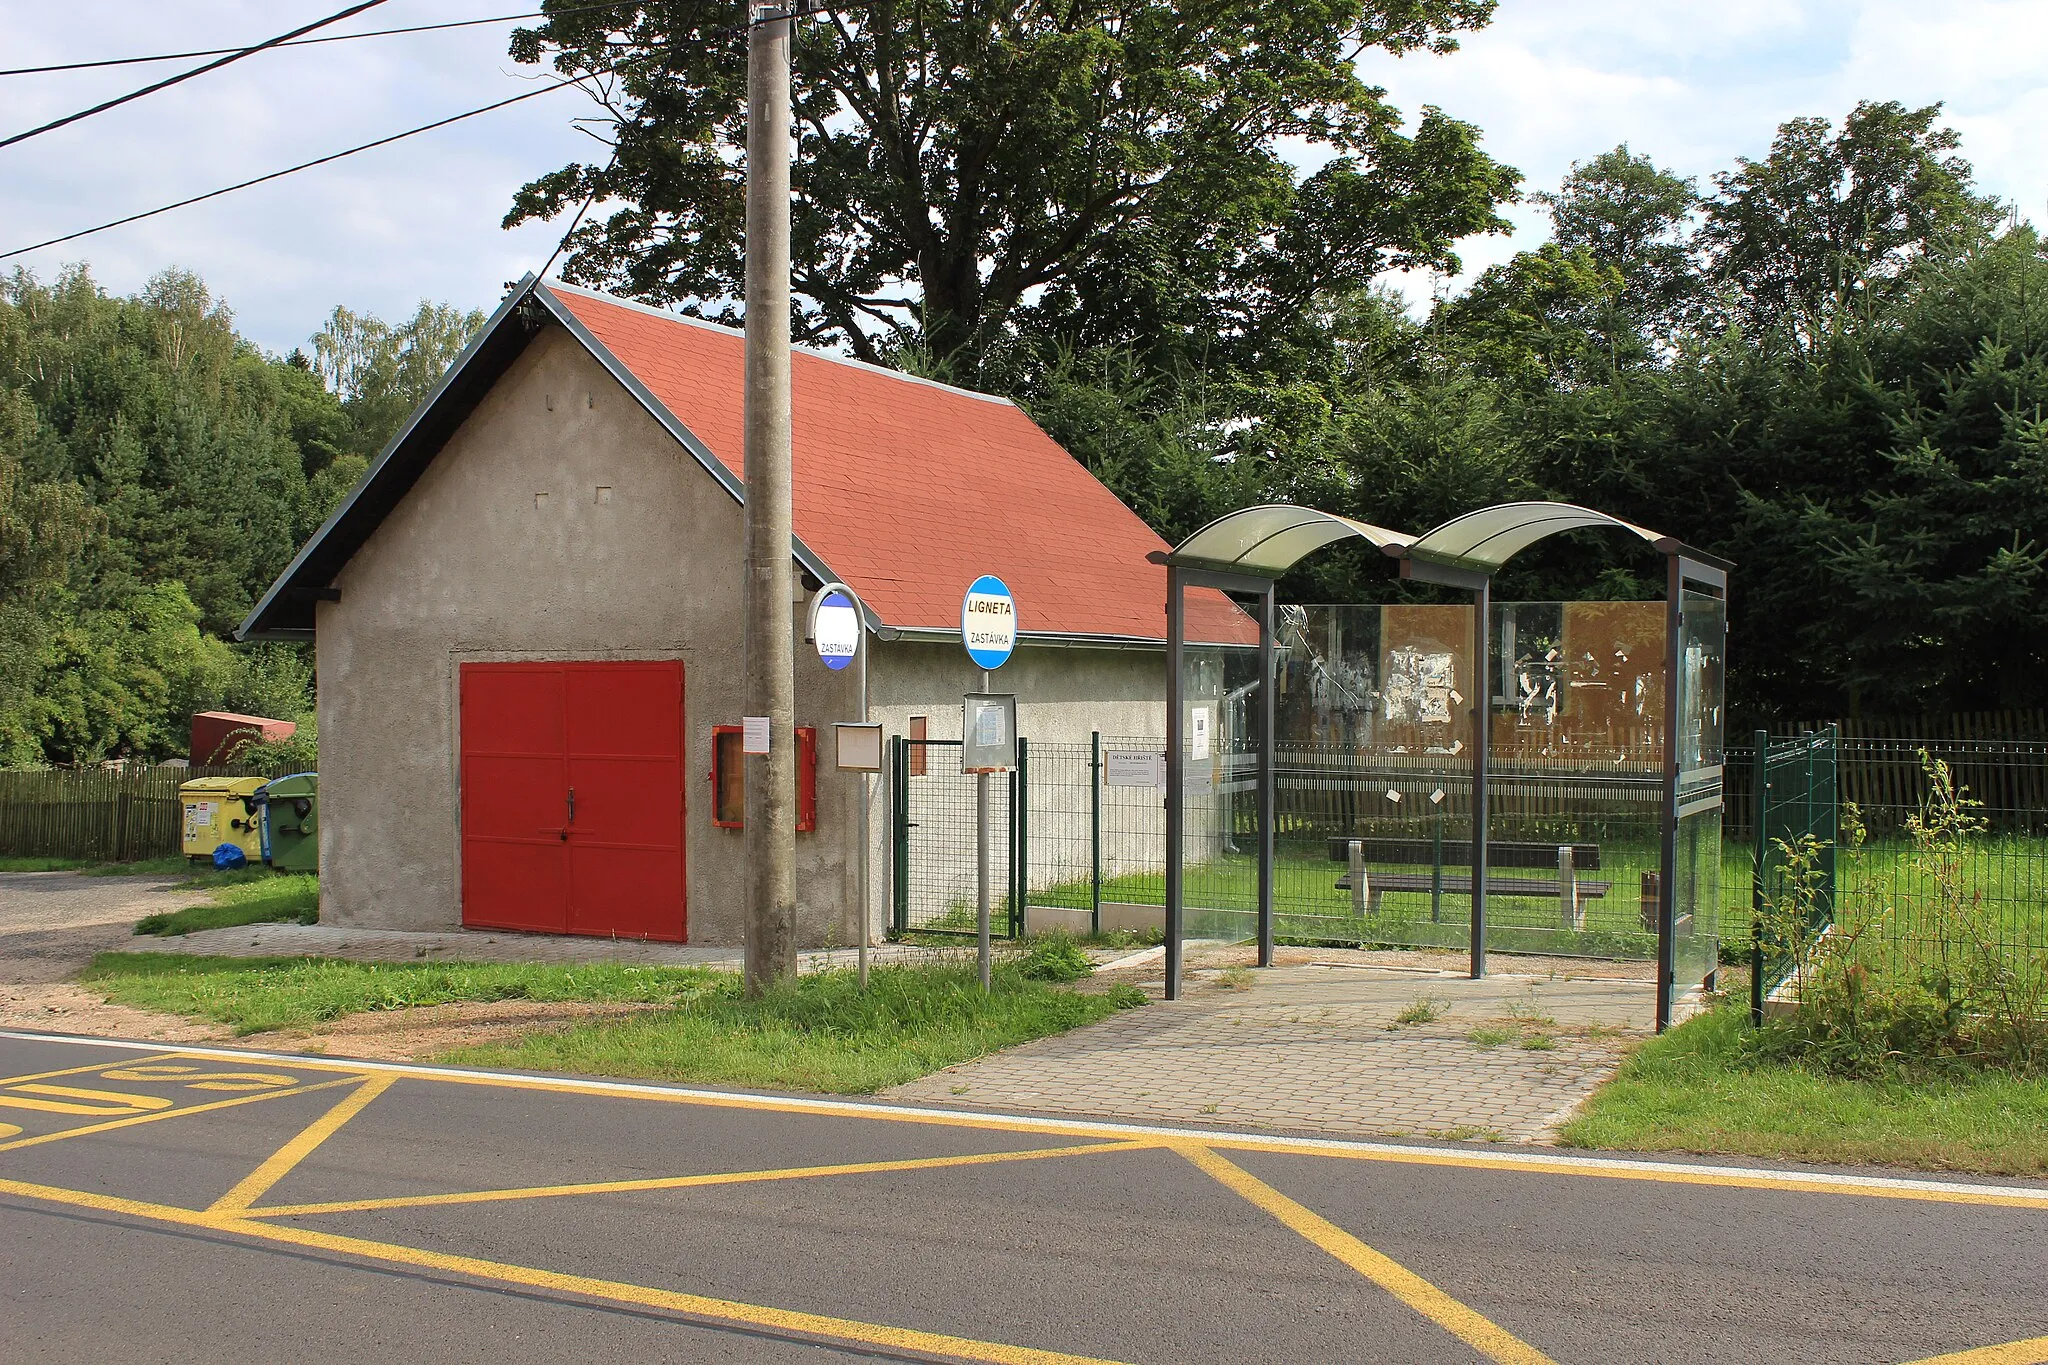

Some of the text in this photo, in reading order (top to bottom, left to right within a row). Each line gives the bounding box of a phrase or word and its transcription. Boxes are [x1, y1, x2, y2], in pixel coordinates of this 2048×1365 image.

[968, 600, 1012, 615] LIGNETA
[970, 631, 1009, 645] ZASTÁVKA
[821, 642, 853, 654] ZASTÁVKA
